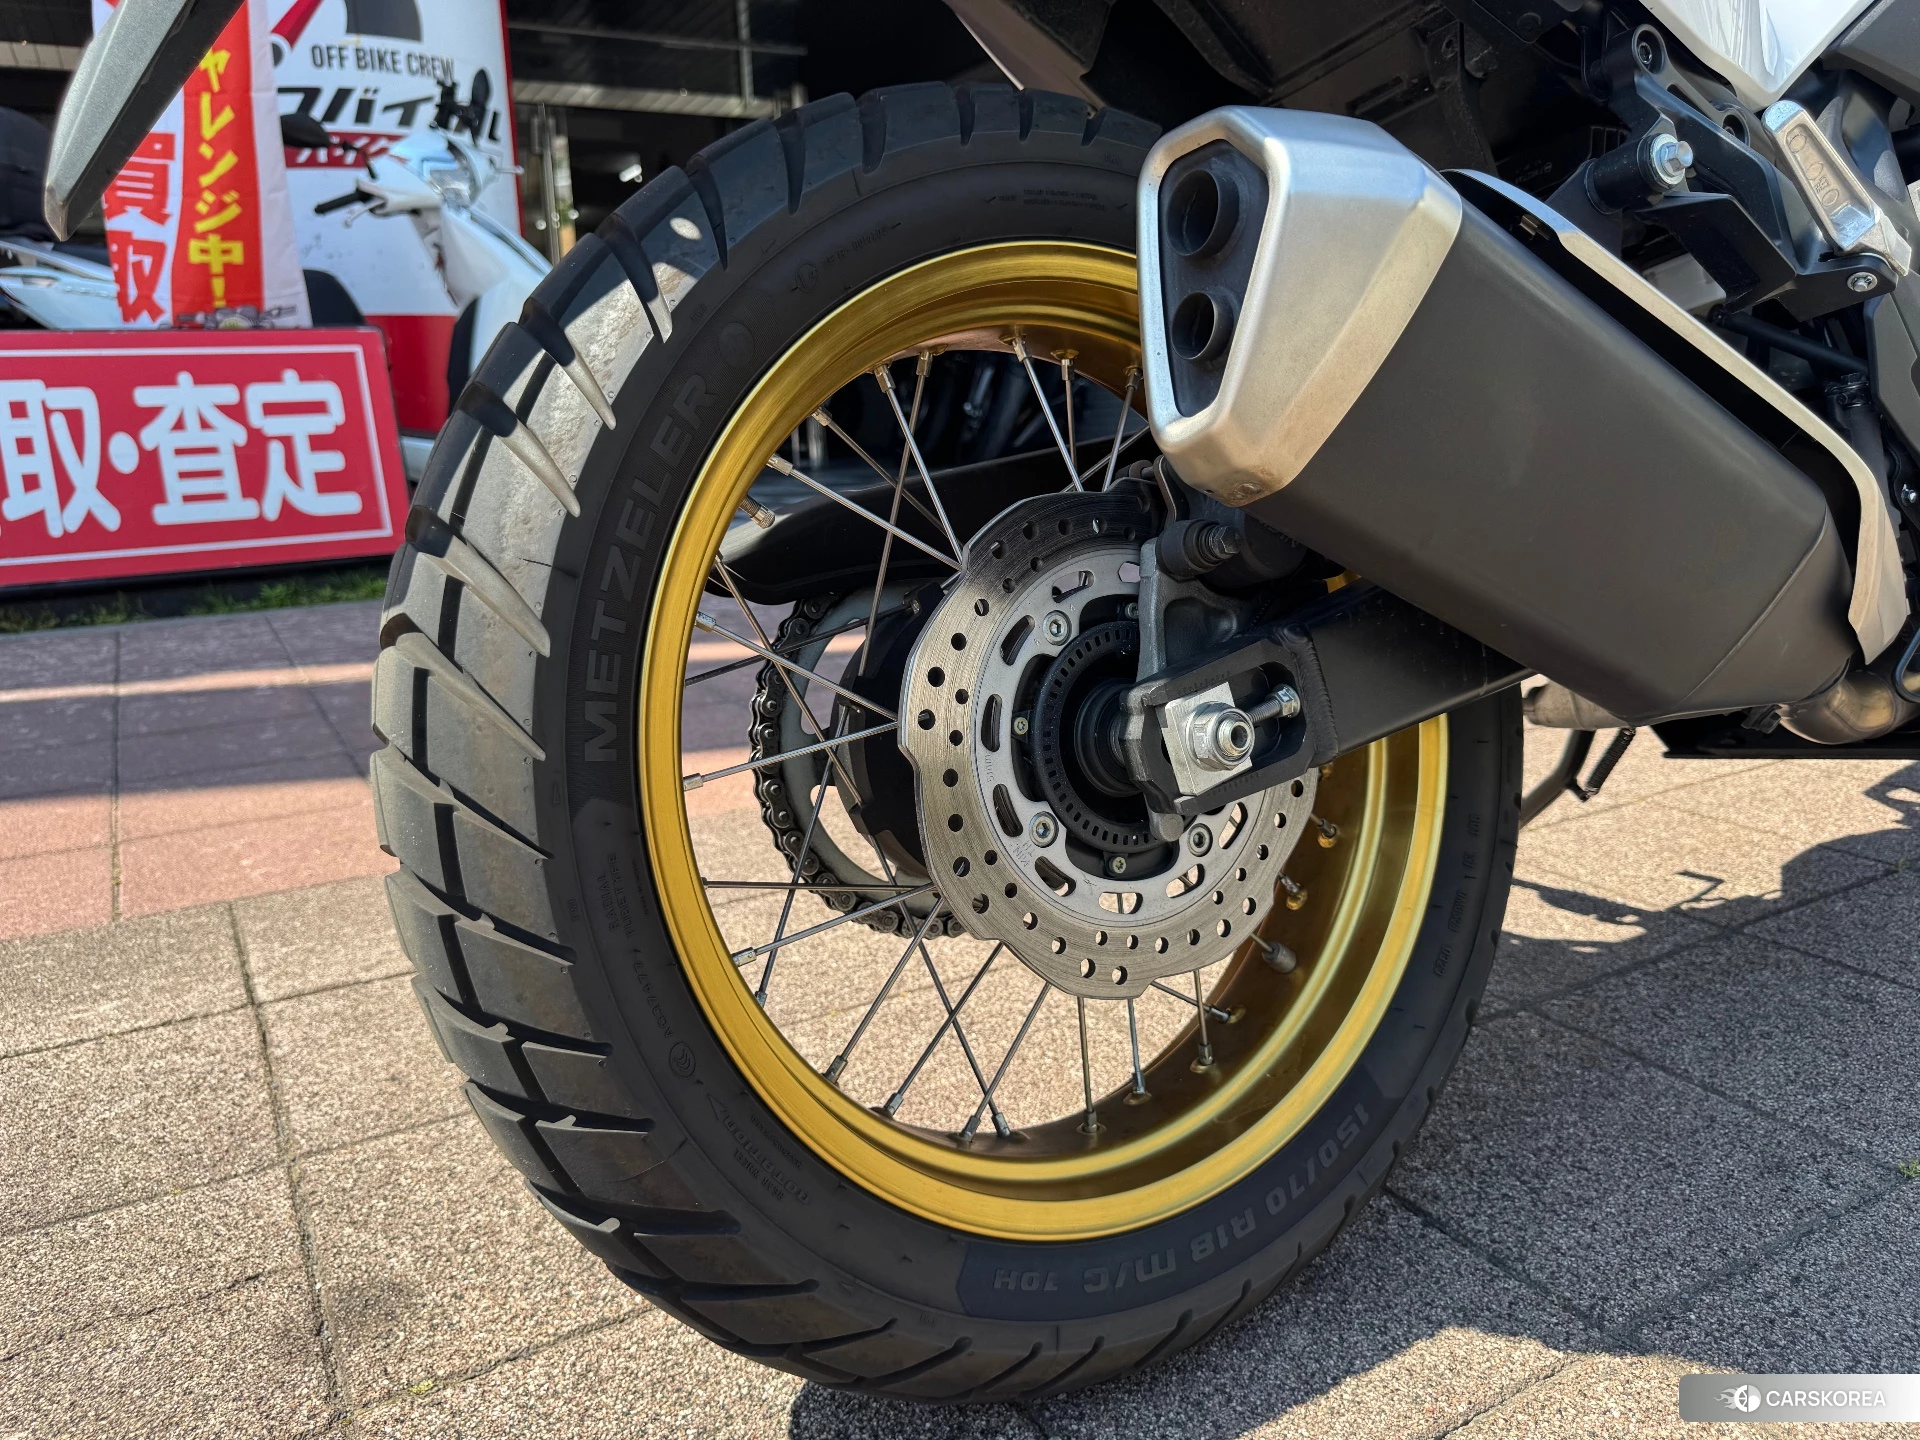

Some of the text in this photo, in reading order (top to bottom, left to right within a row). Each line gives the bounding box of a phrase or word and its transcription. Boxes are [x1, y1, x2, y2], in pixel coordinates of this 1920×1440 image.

[311, 45, 455, 80] OFF BIKE CREW
[584, 374, 718, 763] METZELER
[1264, 1102, 1372, 1216] 150/70
[1189, 1206, 1257, 1262] R18
[993, 1268, 1063, 1292] 70H
